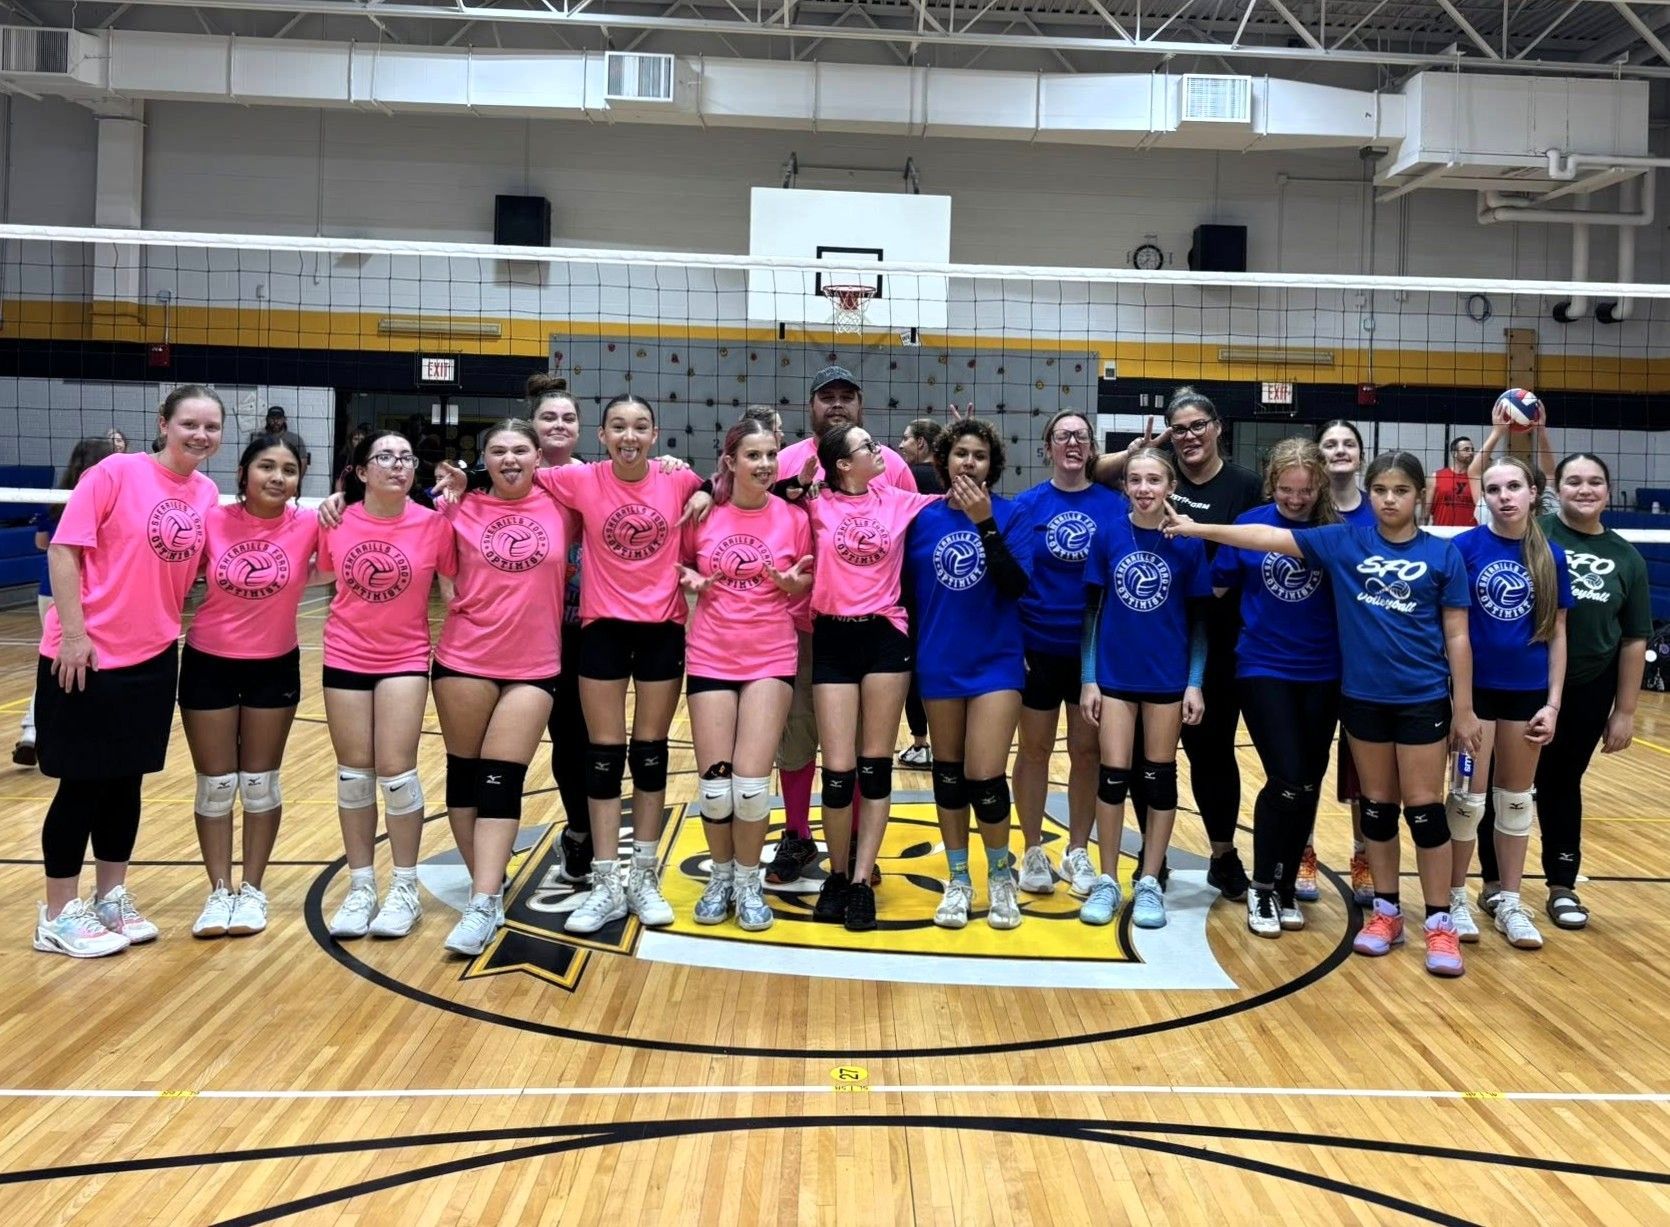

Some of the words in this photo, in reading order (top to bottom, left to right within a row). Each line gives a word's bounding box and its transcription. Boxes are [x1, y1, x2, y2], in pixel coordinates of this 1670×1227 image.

[428, 361, 448, 378] EXIT
[1268, 384, 1289, 400] EXIT
[152, 501, 187, 527] SHERRILLS
[606, 506, 647, 533] SHERRILLS
[650, 512, 666, 532] FORD
[483, 516, 524, 544] SHERRILLS
[529, 521, 546, 543] FORD
[152, 535, 197, 560] OPTIMIST
[219, 541, 269, 570] SHERRILLS
[272, 549, 287, 572] FORD
[486, 549, 544, 570] OPTIMIST
[608, 539, 661, 558] OPTIMIST
[713, 536, 755, 562] SHERRILLS
[837, 543, 886, 564] OPTIMIST
[935, 533, 971, 562] SHERRILLS
[973, 537, 986, 558] FORD
[345, 542, 391, 571] SHERRILLS
[394, 552, 409, 578] FORD
[1116, 553, 1156, 578] SHERRILLS
[1156, 562, 1169, 584] FORD
[1356, 555, 1428, 581] SFO
[937, 567, 983, 588] OPTIMIST
[1479, 562, 1519, 587] SHERRILLS
[219, 578, 281, 598] OPTIMIST
[347, 577, 402, 601] OPTIMIST
[1118, 586, 1164, 609] OPTIMIST
[1266, 578, 1313, 600] OPTIMIST
[1480, 595, 1531, 618] OPTIMIST
[839, 1068, 859, 1080] 27
